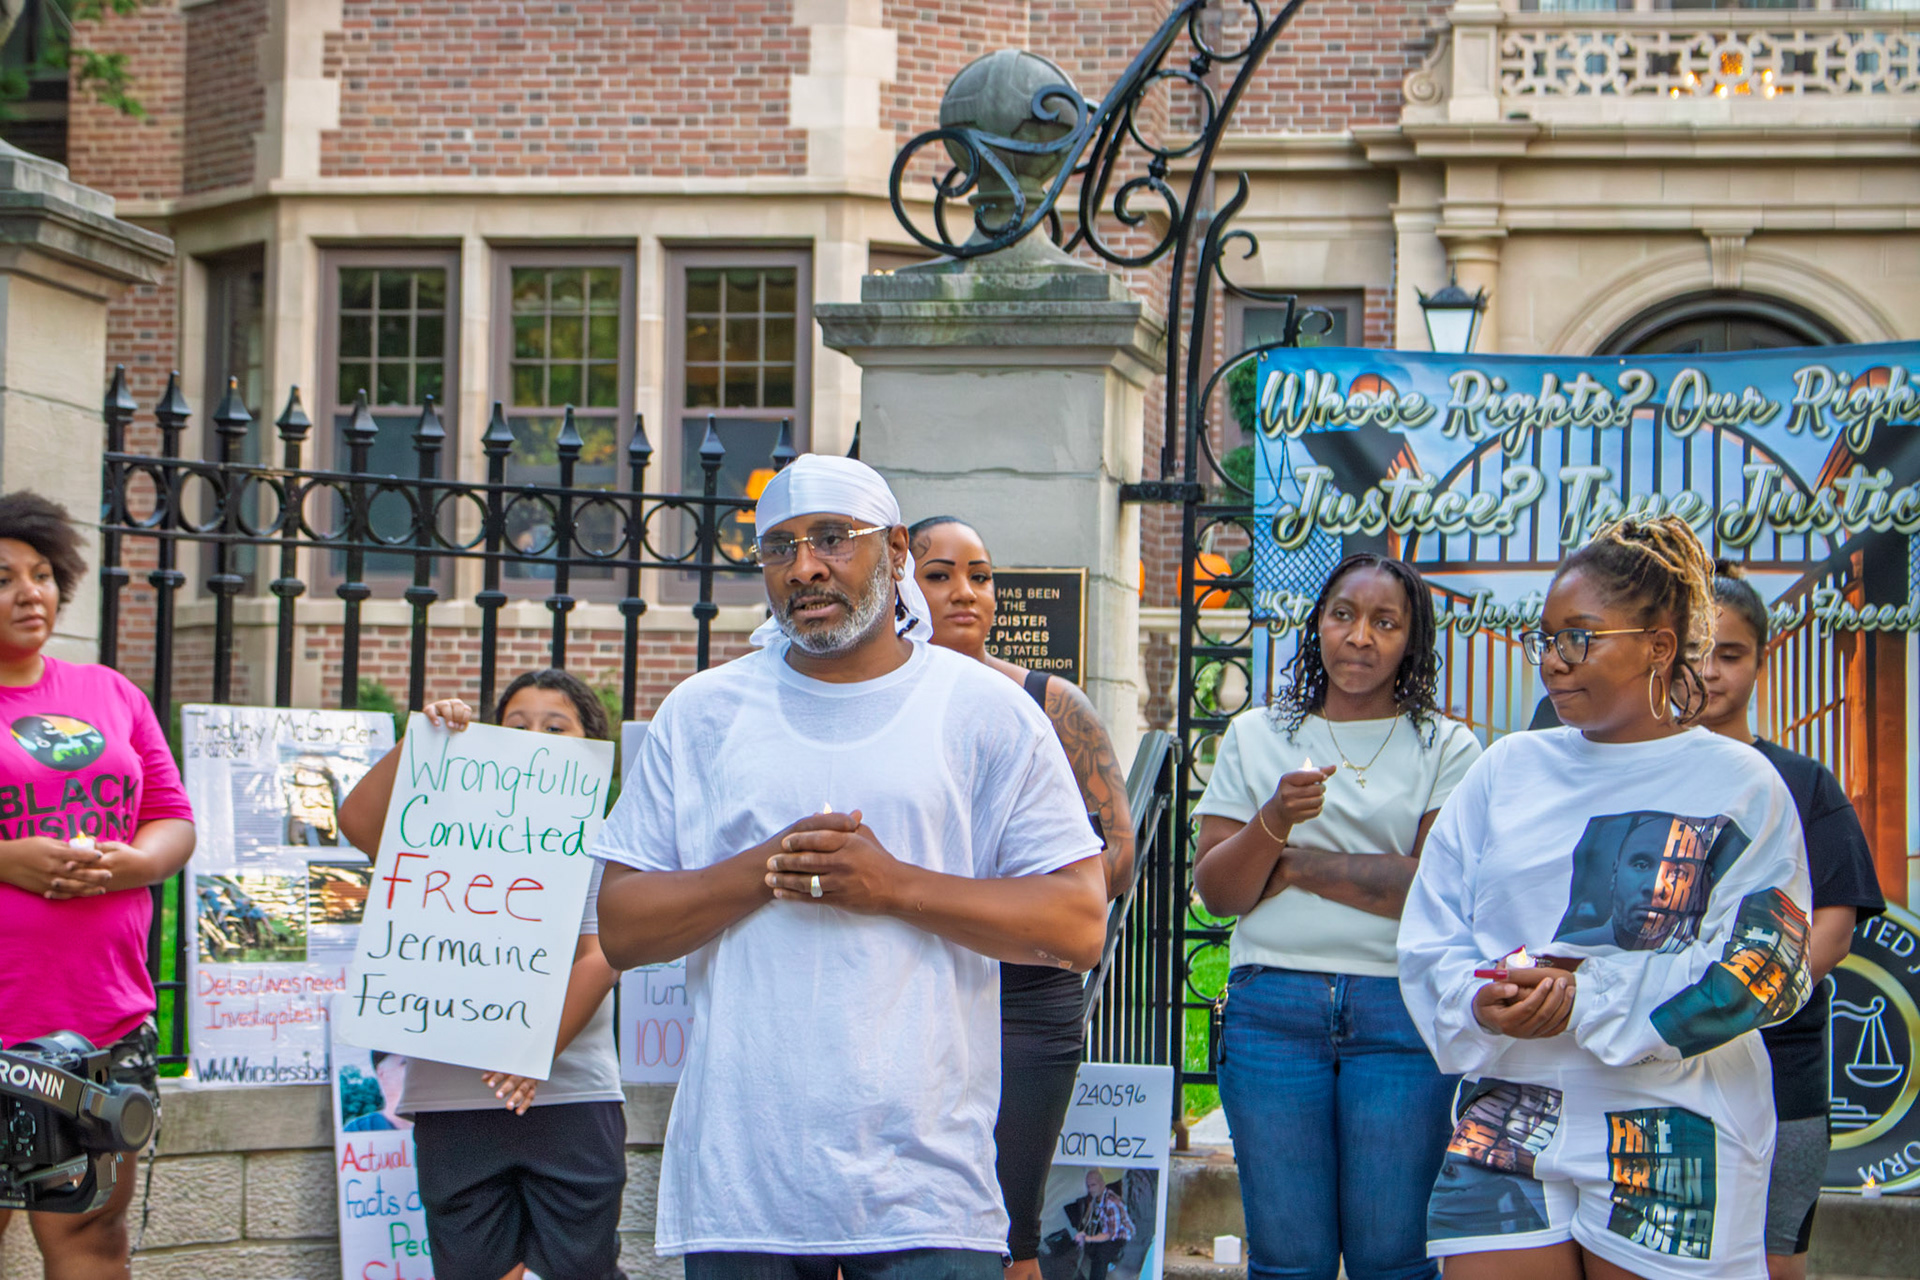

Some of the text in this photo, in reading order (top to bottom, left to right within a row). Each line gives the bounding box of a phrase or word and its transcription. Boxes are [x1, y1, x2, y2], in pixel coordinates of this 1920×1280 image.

[1260, 365, 1920, 458] Whose Rights? Our Righ
[1271, 465, 1546, 550] Justice?
[1558, 465, 1713, 548] True
[997, 587, 1060, 600] HAS BEEN
[1003, 601, 1027, 612] THE
[992, 615, 1048, 627] EGISTER
[996, 631, 1050, 643] PLACES
[1004, 645, 1049, 657] STATES
[1015, 658, 1073, 670] INTERIOR
[410, 728, 601, 819] Wrongfully
[0, 774, 139, 820] BLACK
[400, 794, 592, 857] Convicted
[367, 920, 551, 976] Jermaine
[1862, 915, 1917, 958] TED
[352, 973, 531, 1034] Ferguson
[0, 1060, 65, 1100] RONIN
[1076, 1082, 1147, 1107] 240596
[340, 1139, 412, 1173] Actual
[1857, 1140, 1920, 1182] ORM
